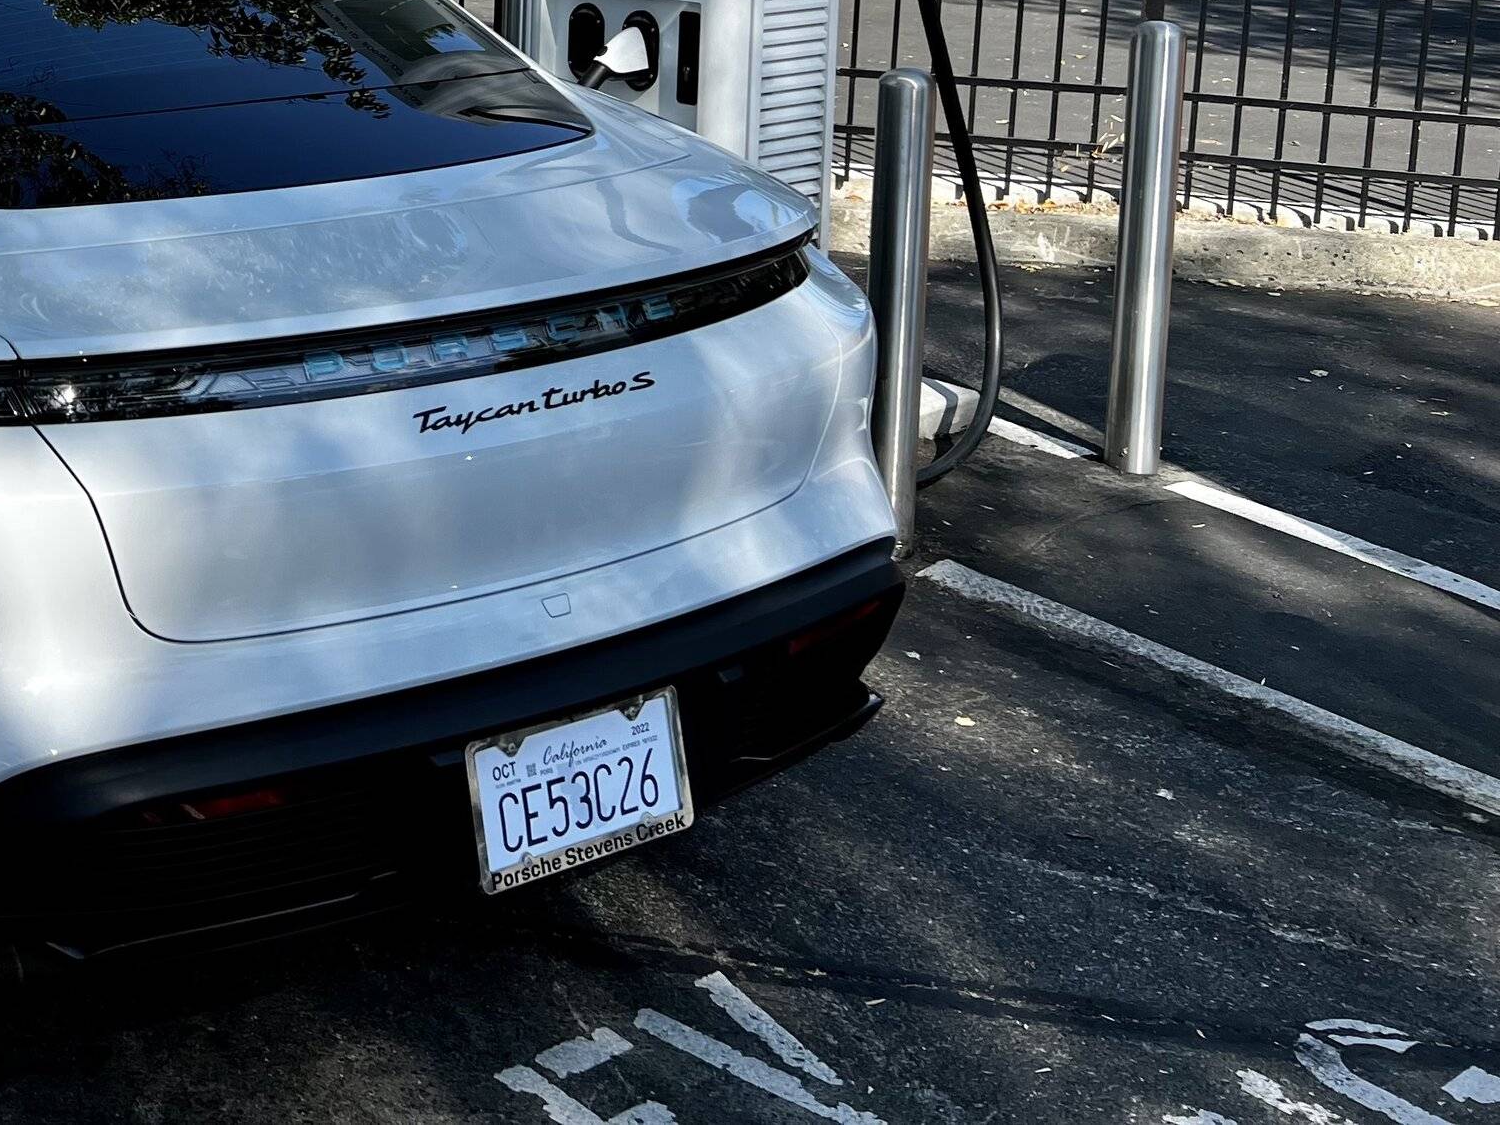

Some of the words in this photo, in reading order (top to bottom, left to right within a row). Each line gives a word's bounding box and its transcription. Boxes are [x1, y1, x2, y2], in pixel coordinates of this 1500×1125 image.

[412, 398, 541, 435] Taycan
[628, 371, 656, 392] S
[543, 735, 607, 768] California
[631, 721, 650, 736] 2022
[492, 761, 516, 781] OCT
[498, 747, 659, 853] CE53C26
[492, 855, 562, 891] Porsche
[565, 830, 633, 865] Stevens
[636, 813, 686, 842] Creek
